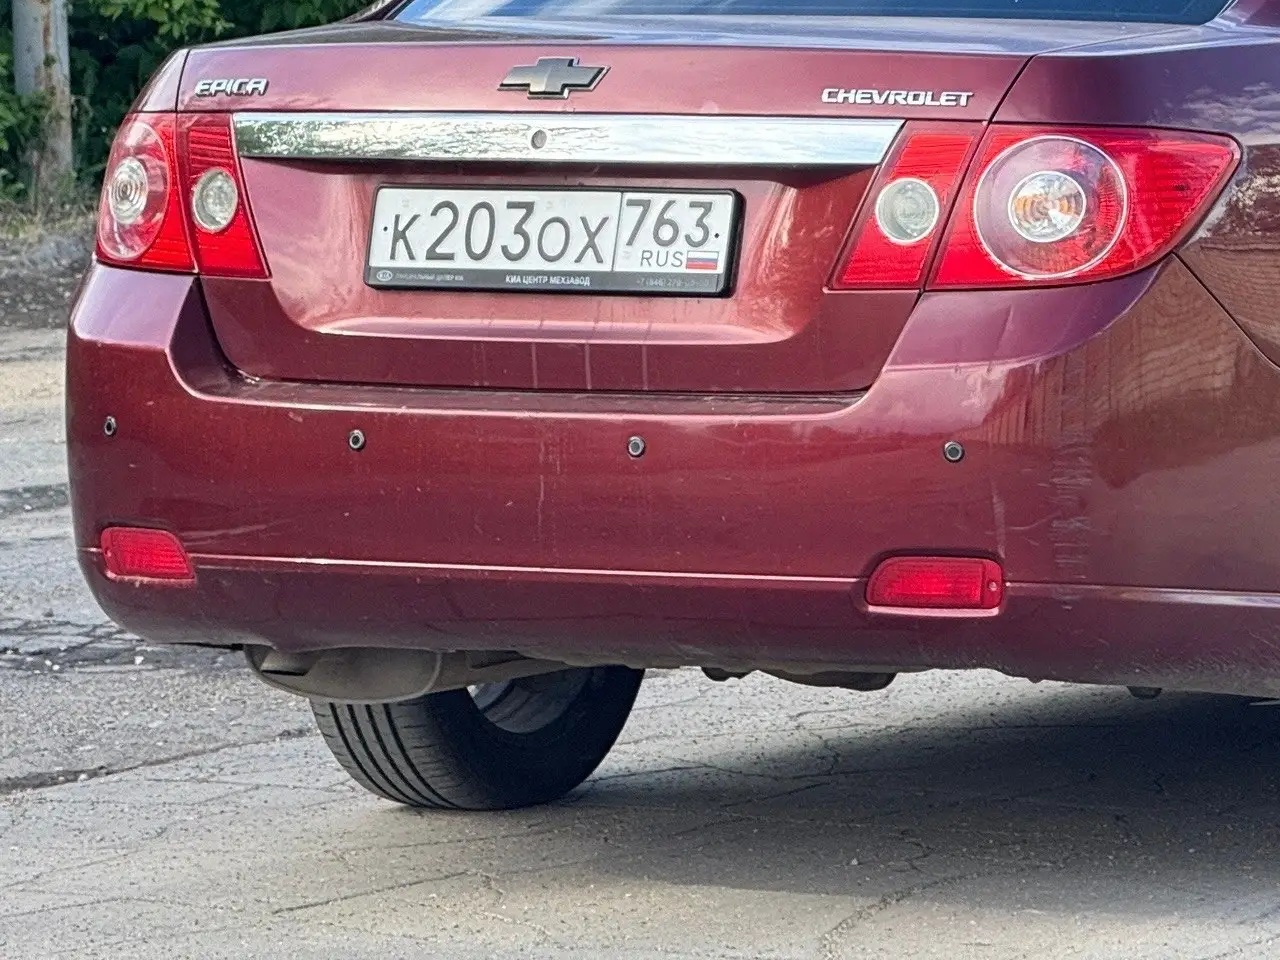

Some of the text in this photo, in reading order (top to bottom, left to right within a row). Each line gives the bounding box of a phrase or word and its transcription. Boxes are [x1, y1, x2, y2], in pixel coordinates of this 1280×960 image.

[194, 78, 268, 96] EPICA
[821, 88, 975, 107] CHEVROLET
[625, 198, 714, 248] 763
[640, 249, 684, 268] RUS
[522, 275, 548, 284] ЦЕНТР
[549, 276, 591, 286] МЕХЗАВОД
